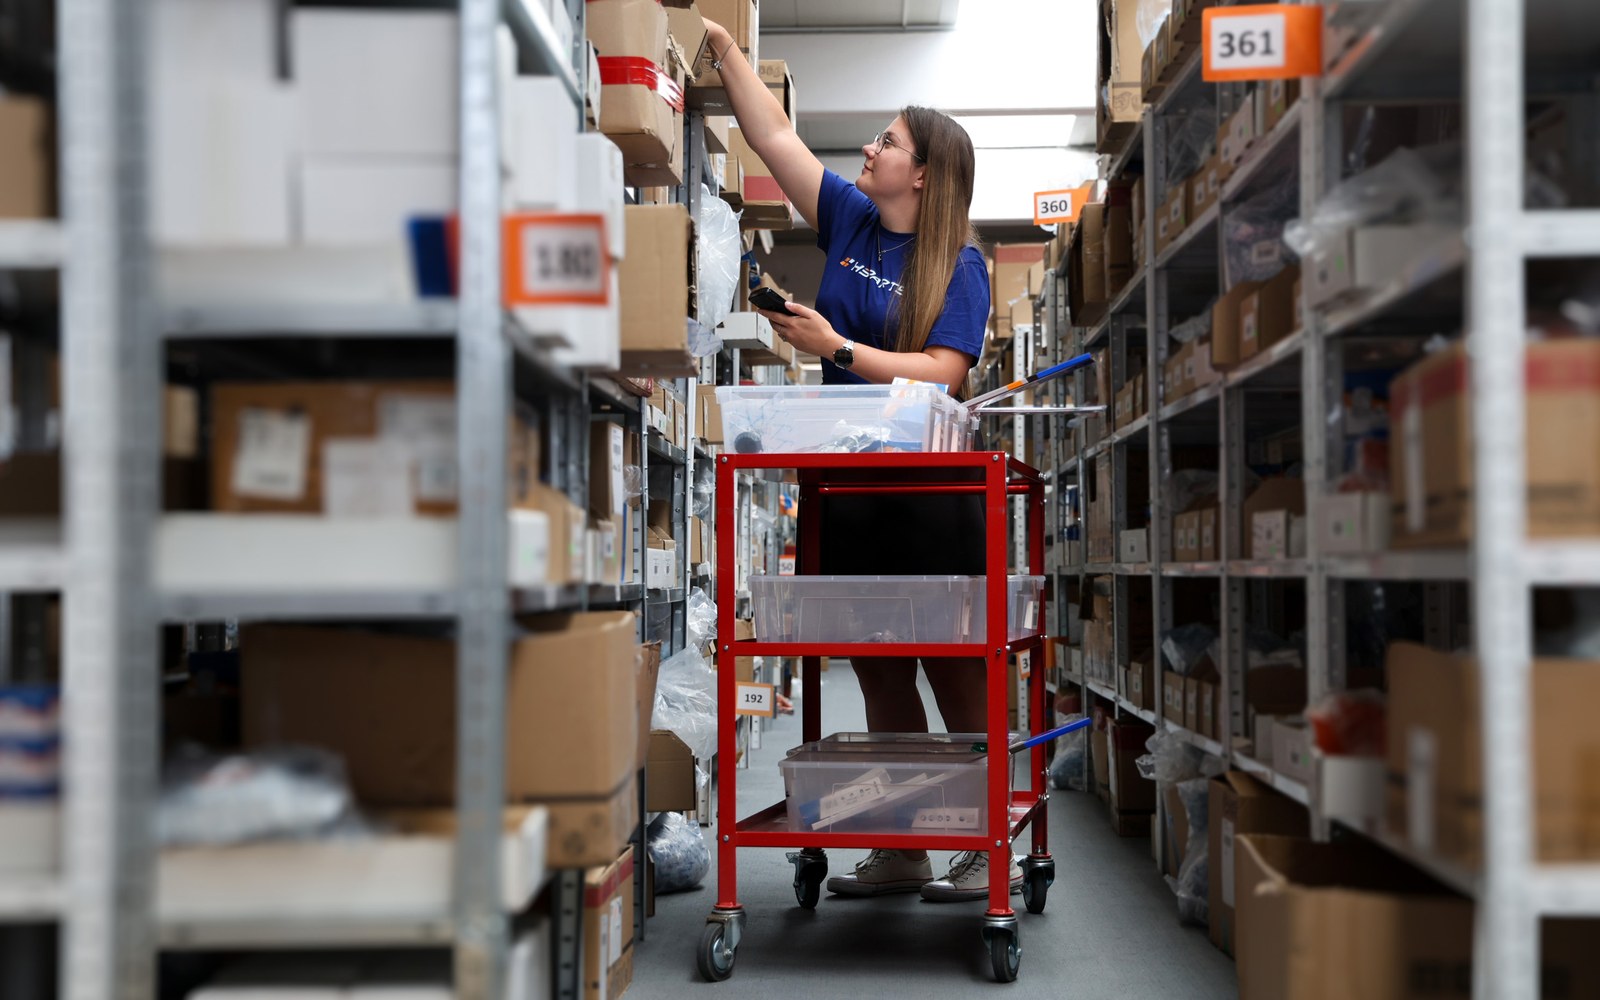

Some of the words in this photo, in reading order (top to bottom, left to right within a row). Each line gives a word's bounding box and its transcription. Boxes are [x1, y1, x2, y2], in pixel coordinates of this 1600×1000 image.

[1218, 29, 1274, 58] 361
[1040, 199, 1068, 214] 360
[1022, 657, 1030, 669] 3
[744, 693, 763, 704] 192
